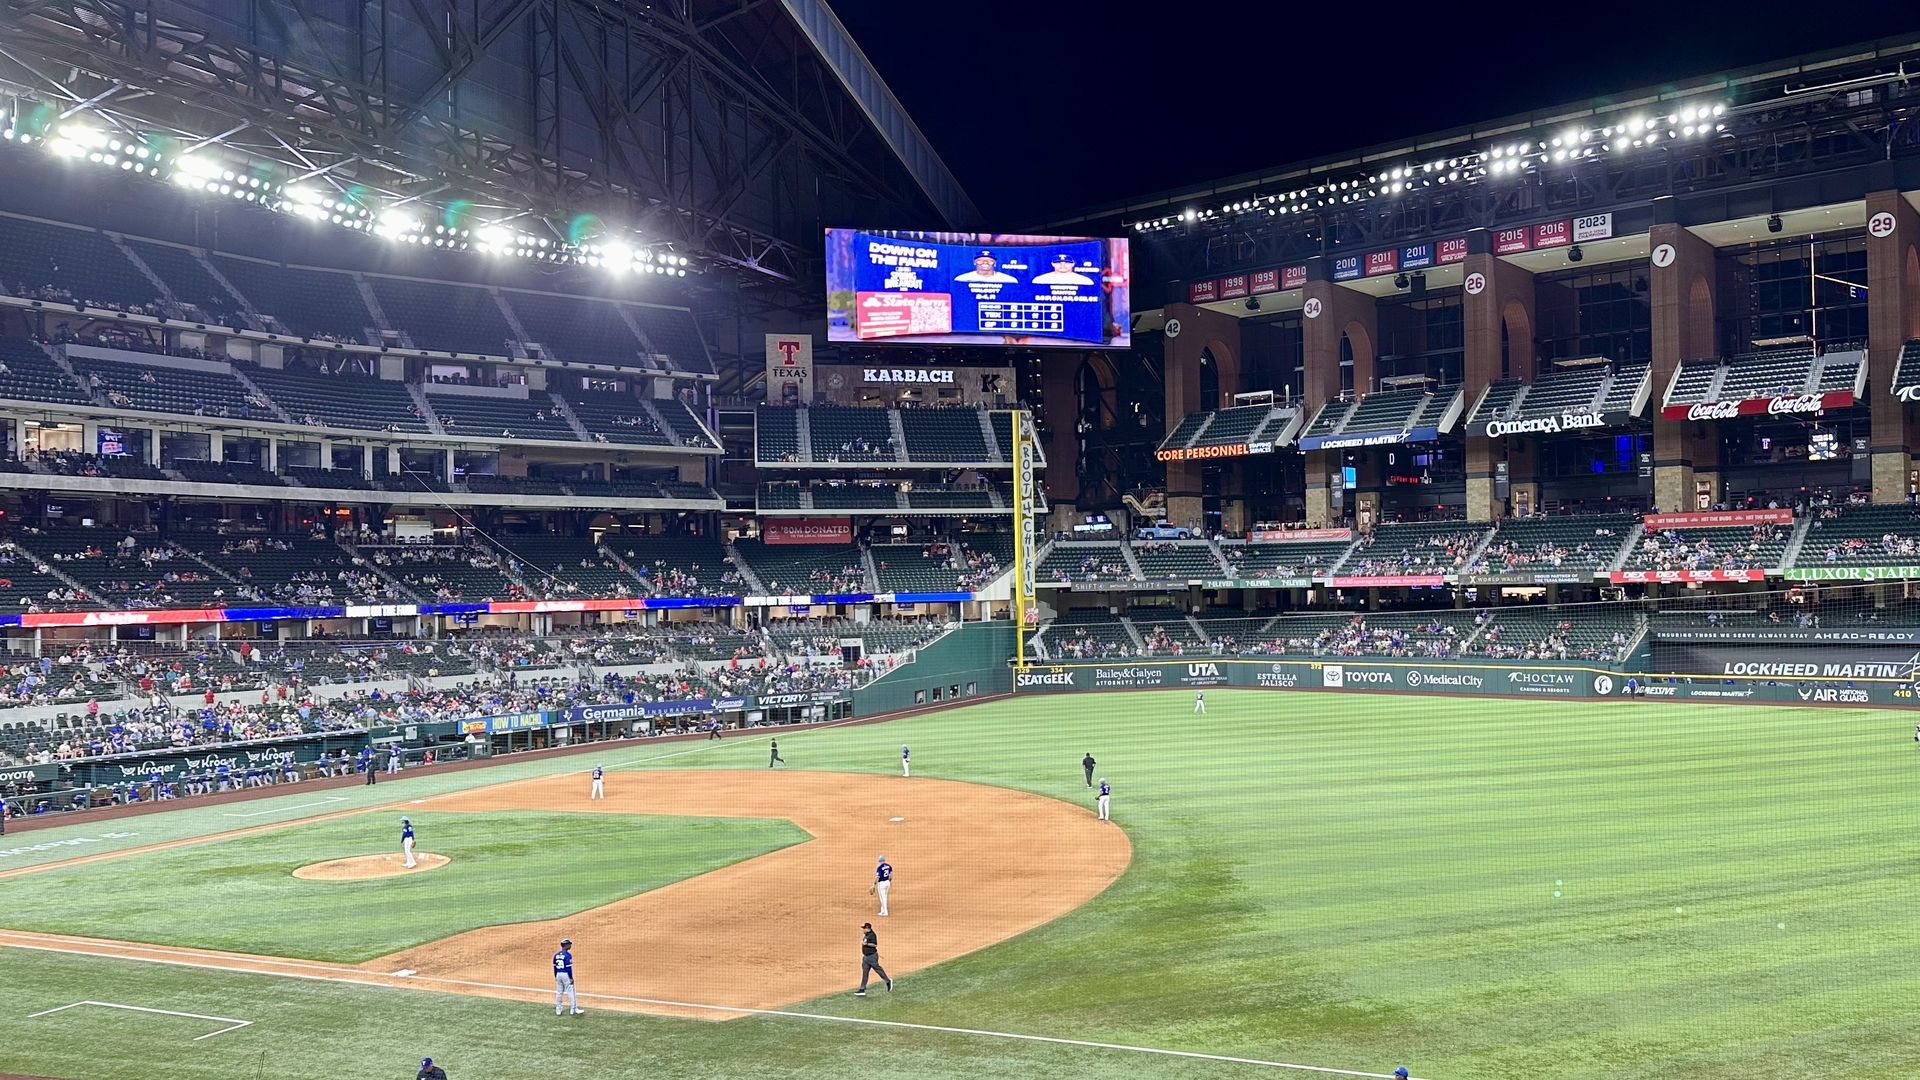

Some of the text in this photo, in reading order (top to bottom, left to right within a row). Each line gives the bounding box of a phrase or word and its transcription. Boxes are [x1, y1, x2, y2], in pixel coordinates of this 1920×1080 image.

[1578, 215, 1607, 229] 2023
[1872, 218, 1892, 232] 29
[1500, 229, 1524, 242] 2015
[1540, 222, 1565, 236] 2016
[868, 242, 938, 259] DOWN ON
[1406, 246, 1426, 258] 2011
[1442, 240, 1466, 252] 2012
[869, 253, 939, 269] THE FARM
[1372, 252, 1392, 264] 2011
[1660, 249, 1668, 263] 7
[1336, 258, 1357, 270] 2010
[1255, 272, 1274, 284] 1999
[1287, 266, 1307, 278] 2010
[1194, 282, 1214, 293] 1996
[1225, 277, 1244, 288] 1998
[1467, 278, 1483, 290] 26
[1306, 304, 1320, 314] 34
[1166, 322, 1180, 334] 42
[772, 368, 808, 378] TEXAS
[864, 369, 954, 384] KARBACH
[1562, 412, 1606, 429] Bank
[1321, 436, 1397, 450] LOCKHEED MARTIN
[1157, 444, 1249, 462] CORE PERSONNEL
[1024, 502, 1032, 515] 4
[804, 526, 850, 534] DONATED
[1024, 520, 1034, 594] CHIKIN
[1801, 567, 1864, 580] LUXOR
[1814, 632, 1915, 640] AHEAD-READY
[1188, 663, 1219, 676] UTA
[1724, 662, 1898, 677] LOCKHEED MARTIN
[1017, 672, 1074, 687] SEATGEEK
[1257, 673, 1298, 681] ESTRELLA
[1345, 672, 1394, 683] TOYOTA
[1423, 674, 1484, 688] Medical City
[1514, 672, 1575, 684] CHOCTAW
[758, 694, 804, 705] VICTORY
[1814, 689, 1838, 702] AIR
[1840, 694, 1869, 702] GUARD
[1893, 690, 1911, 698] 410
[582, 704, 697, 720] Germania INSURANCE
[492, 717, 510, 730] HOW
[511, 716, 520, 728] TO
[261, 750, 295, 766] Kroger
[137, 764, 176, 776] Kroger
